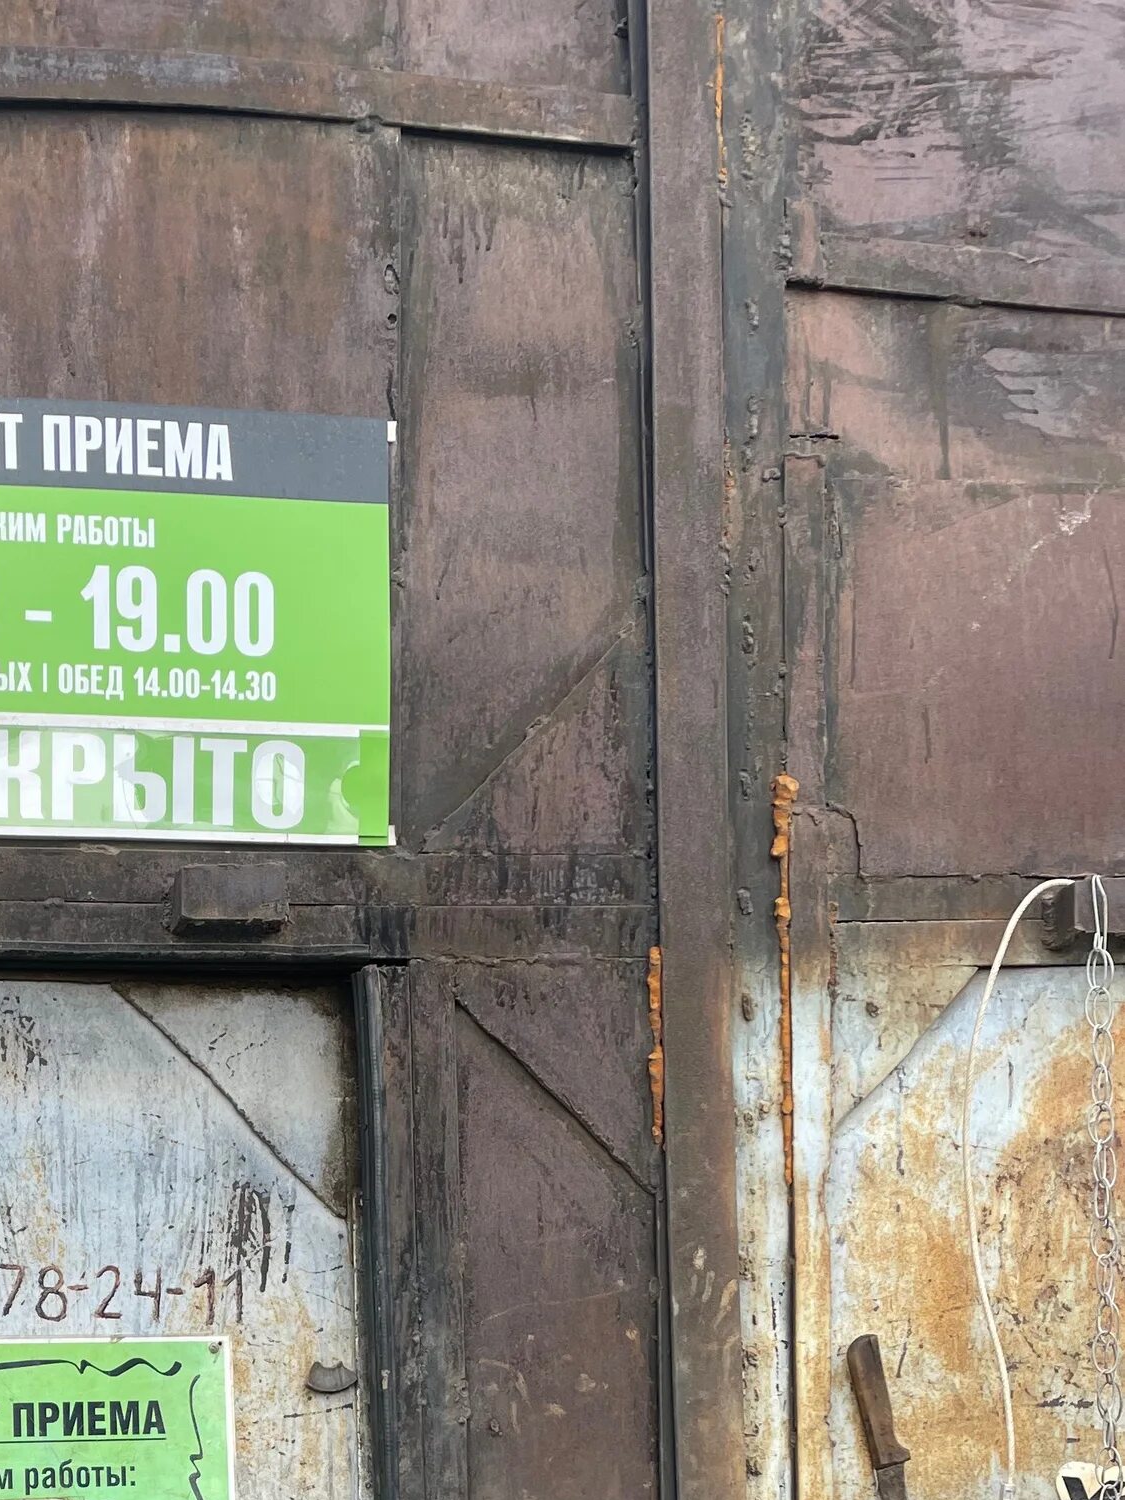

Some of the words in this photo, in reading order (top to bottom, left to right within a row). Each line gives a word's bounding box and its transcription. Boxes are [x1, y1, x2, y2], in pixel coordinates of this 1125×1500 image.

[43, 414, 234, 482] ПРИЕМА
[56, 513, 156, 548] РАБОТЫ
[80, 565, 275, 657] 19.00
[58, 663, 125, 701] ОБЕД
[133, 666, 277, 702] 14.00-14.30
[12, 1399, 167, 1438] ПРИЕМА
[24, 1459, 138, 1495] работы:
